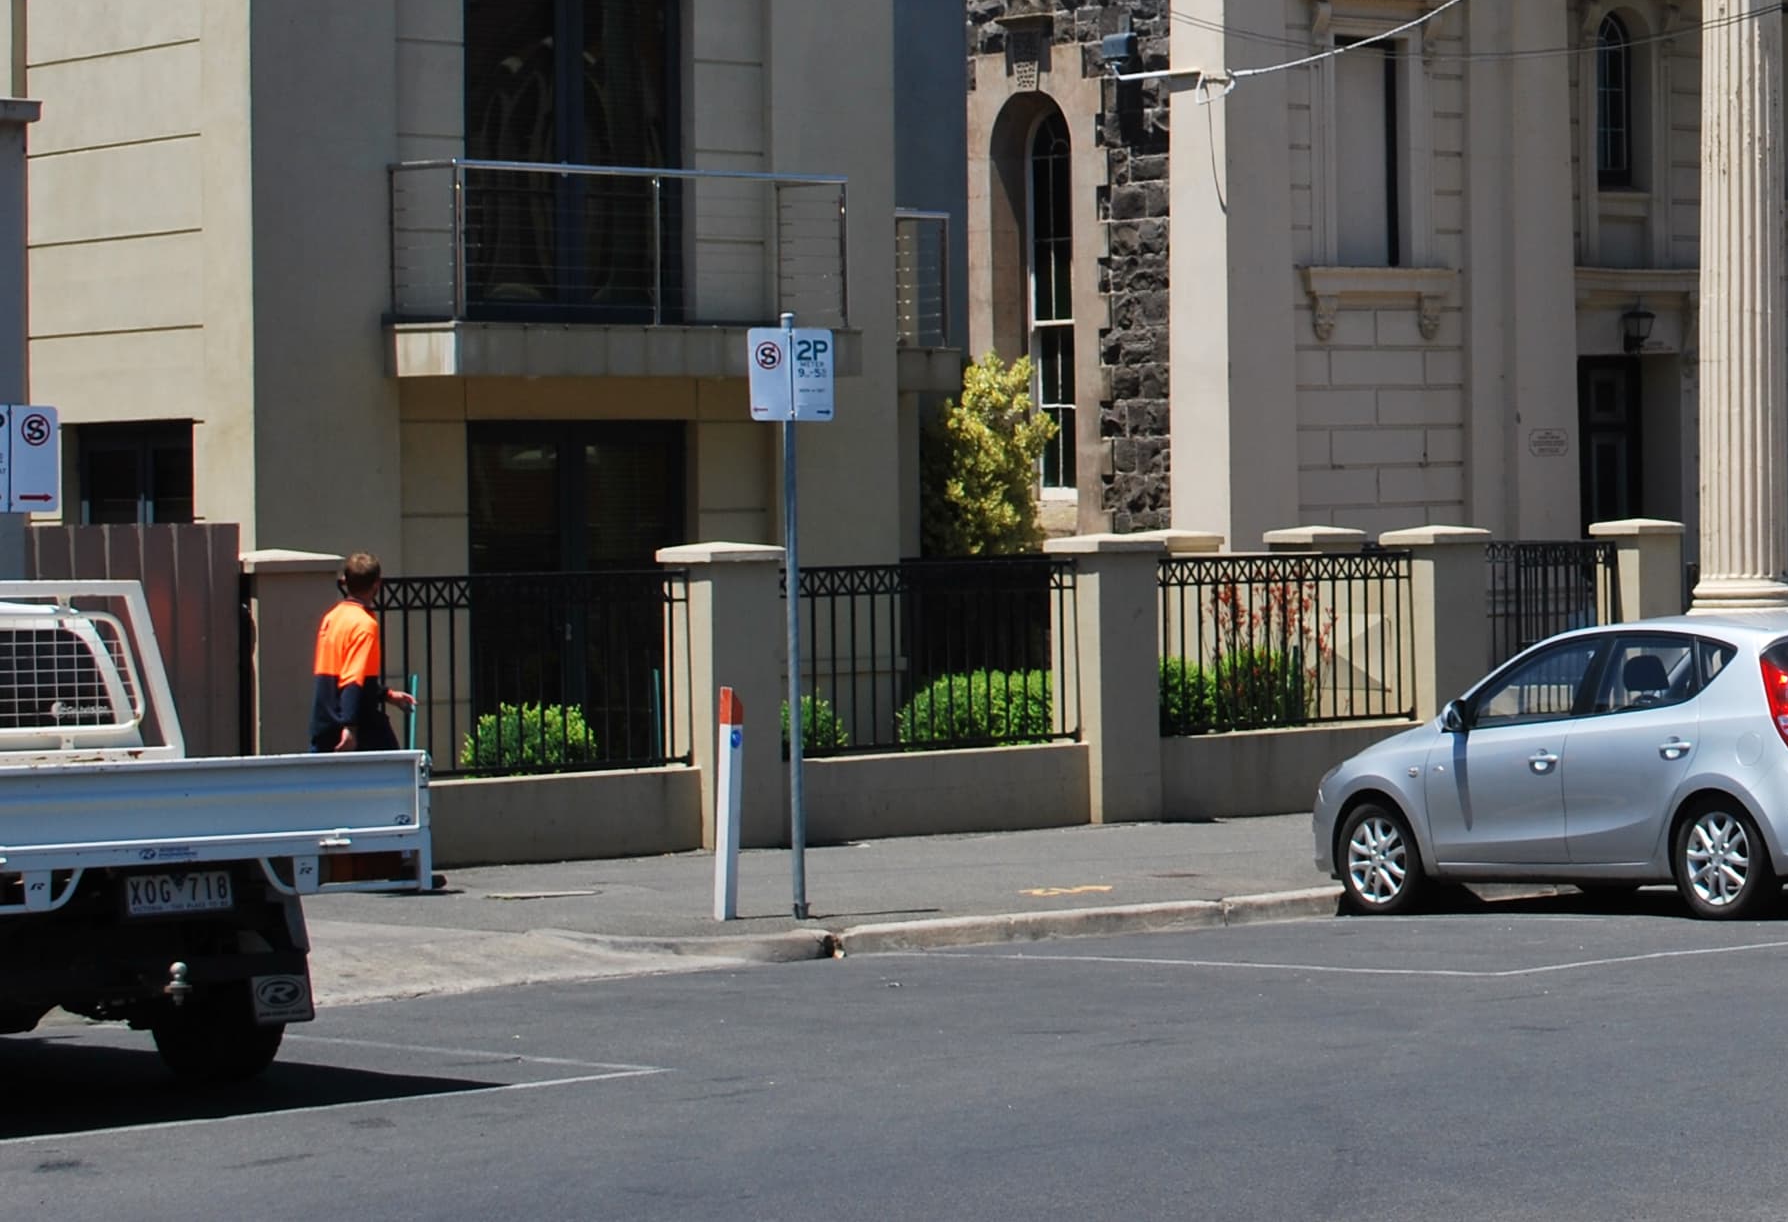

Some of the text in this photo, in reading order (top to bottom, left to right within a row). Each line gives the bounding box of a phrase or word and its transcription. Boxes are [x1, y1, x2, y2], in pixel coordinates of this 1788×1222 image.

[797, 340, 828, 361] 2P
[131, 876, 228, 905] XOG 718
